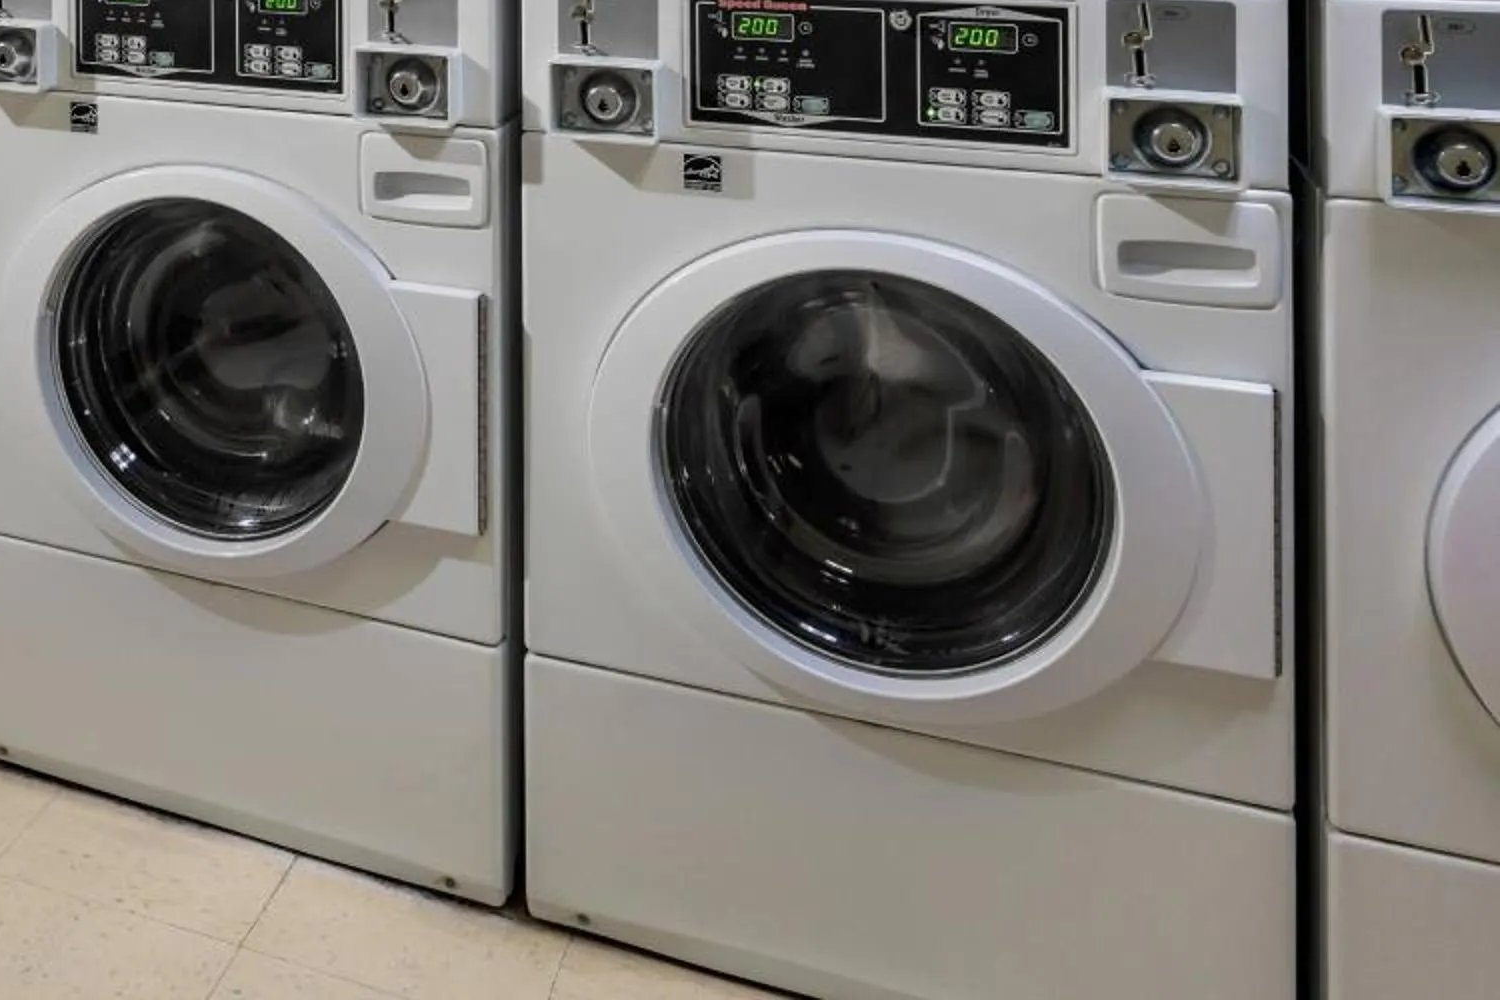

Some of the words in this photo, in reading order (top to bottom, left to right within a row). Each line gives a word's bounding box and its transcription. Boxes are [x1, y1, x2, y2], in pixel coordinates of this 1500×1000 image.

[763, 0, 808, 11] Queen
[738, 17, 779, 35] 200
[954, 27, 999, 47] 200
